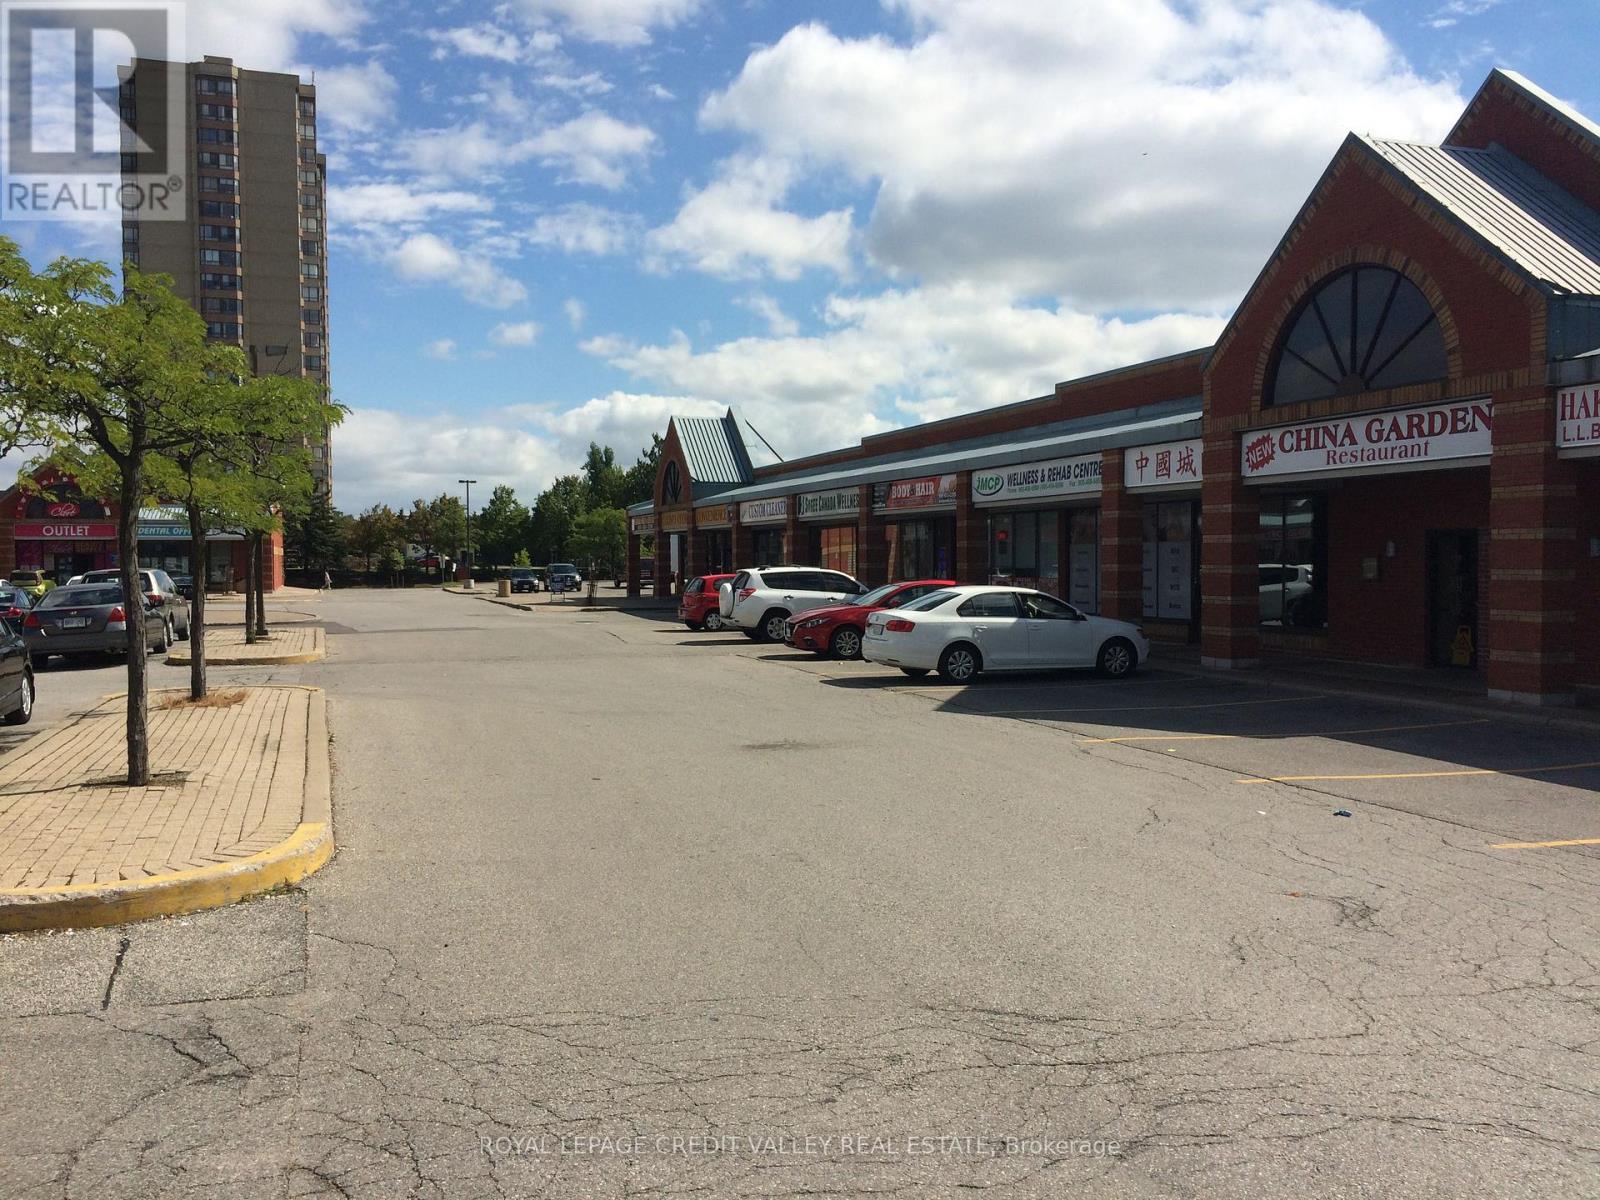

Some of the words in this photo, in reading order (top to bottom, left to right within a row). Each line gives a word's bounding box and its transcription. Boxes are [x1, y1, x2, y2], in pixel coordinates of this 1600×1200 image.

[1278, 422, 1358, 454] CHINA
[1365, 403, 1494, 444] GARDEN
[1135, 446, 1197, 483] 中國城
[1248, 439, 1274, 465] NEW
[1326, 439, 1431, 466] Restaurant
[1007, 469, 1039, 487] WELLNESS
[1040, 468, 1046, 483] &
[1047, 463, 1072, 482] REHAB
[1073, 460, 1103, 479] CENTRE
[891, 484, 910, 499] BODY
[915, 481, 934, 497] HAIR
[42, 526, 91, 536] OUTLET
[138, 527, 170, 535] DENTAL
